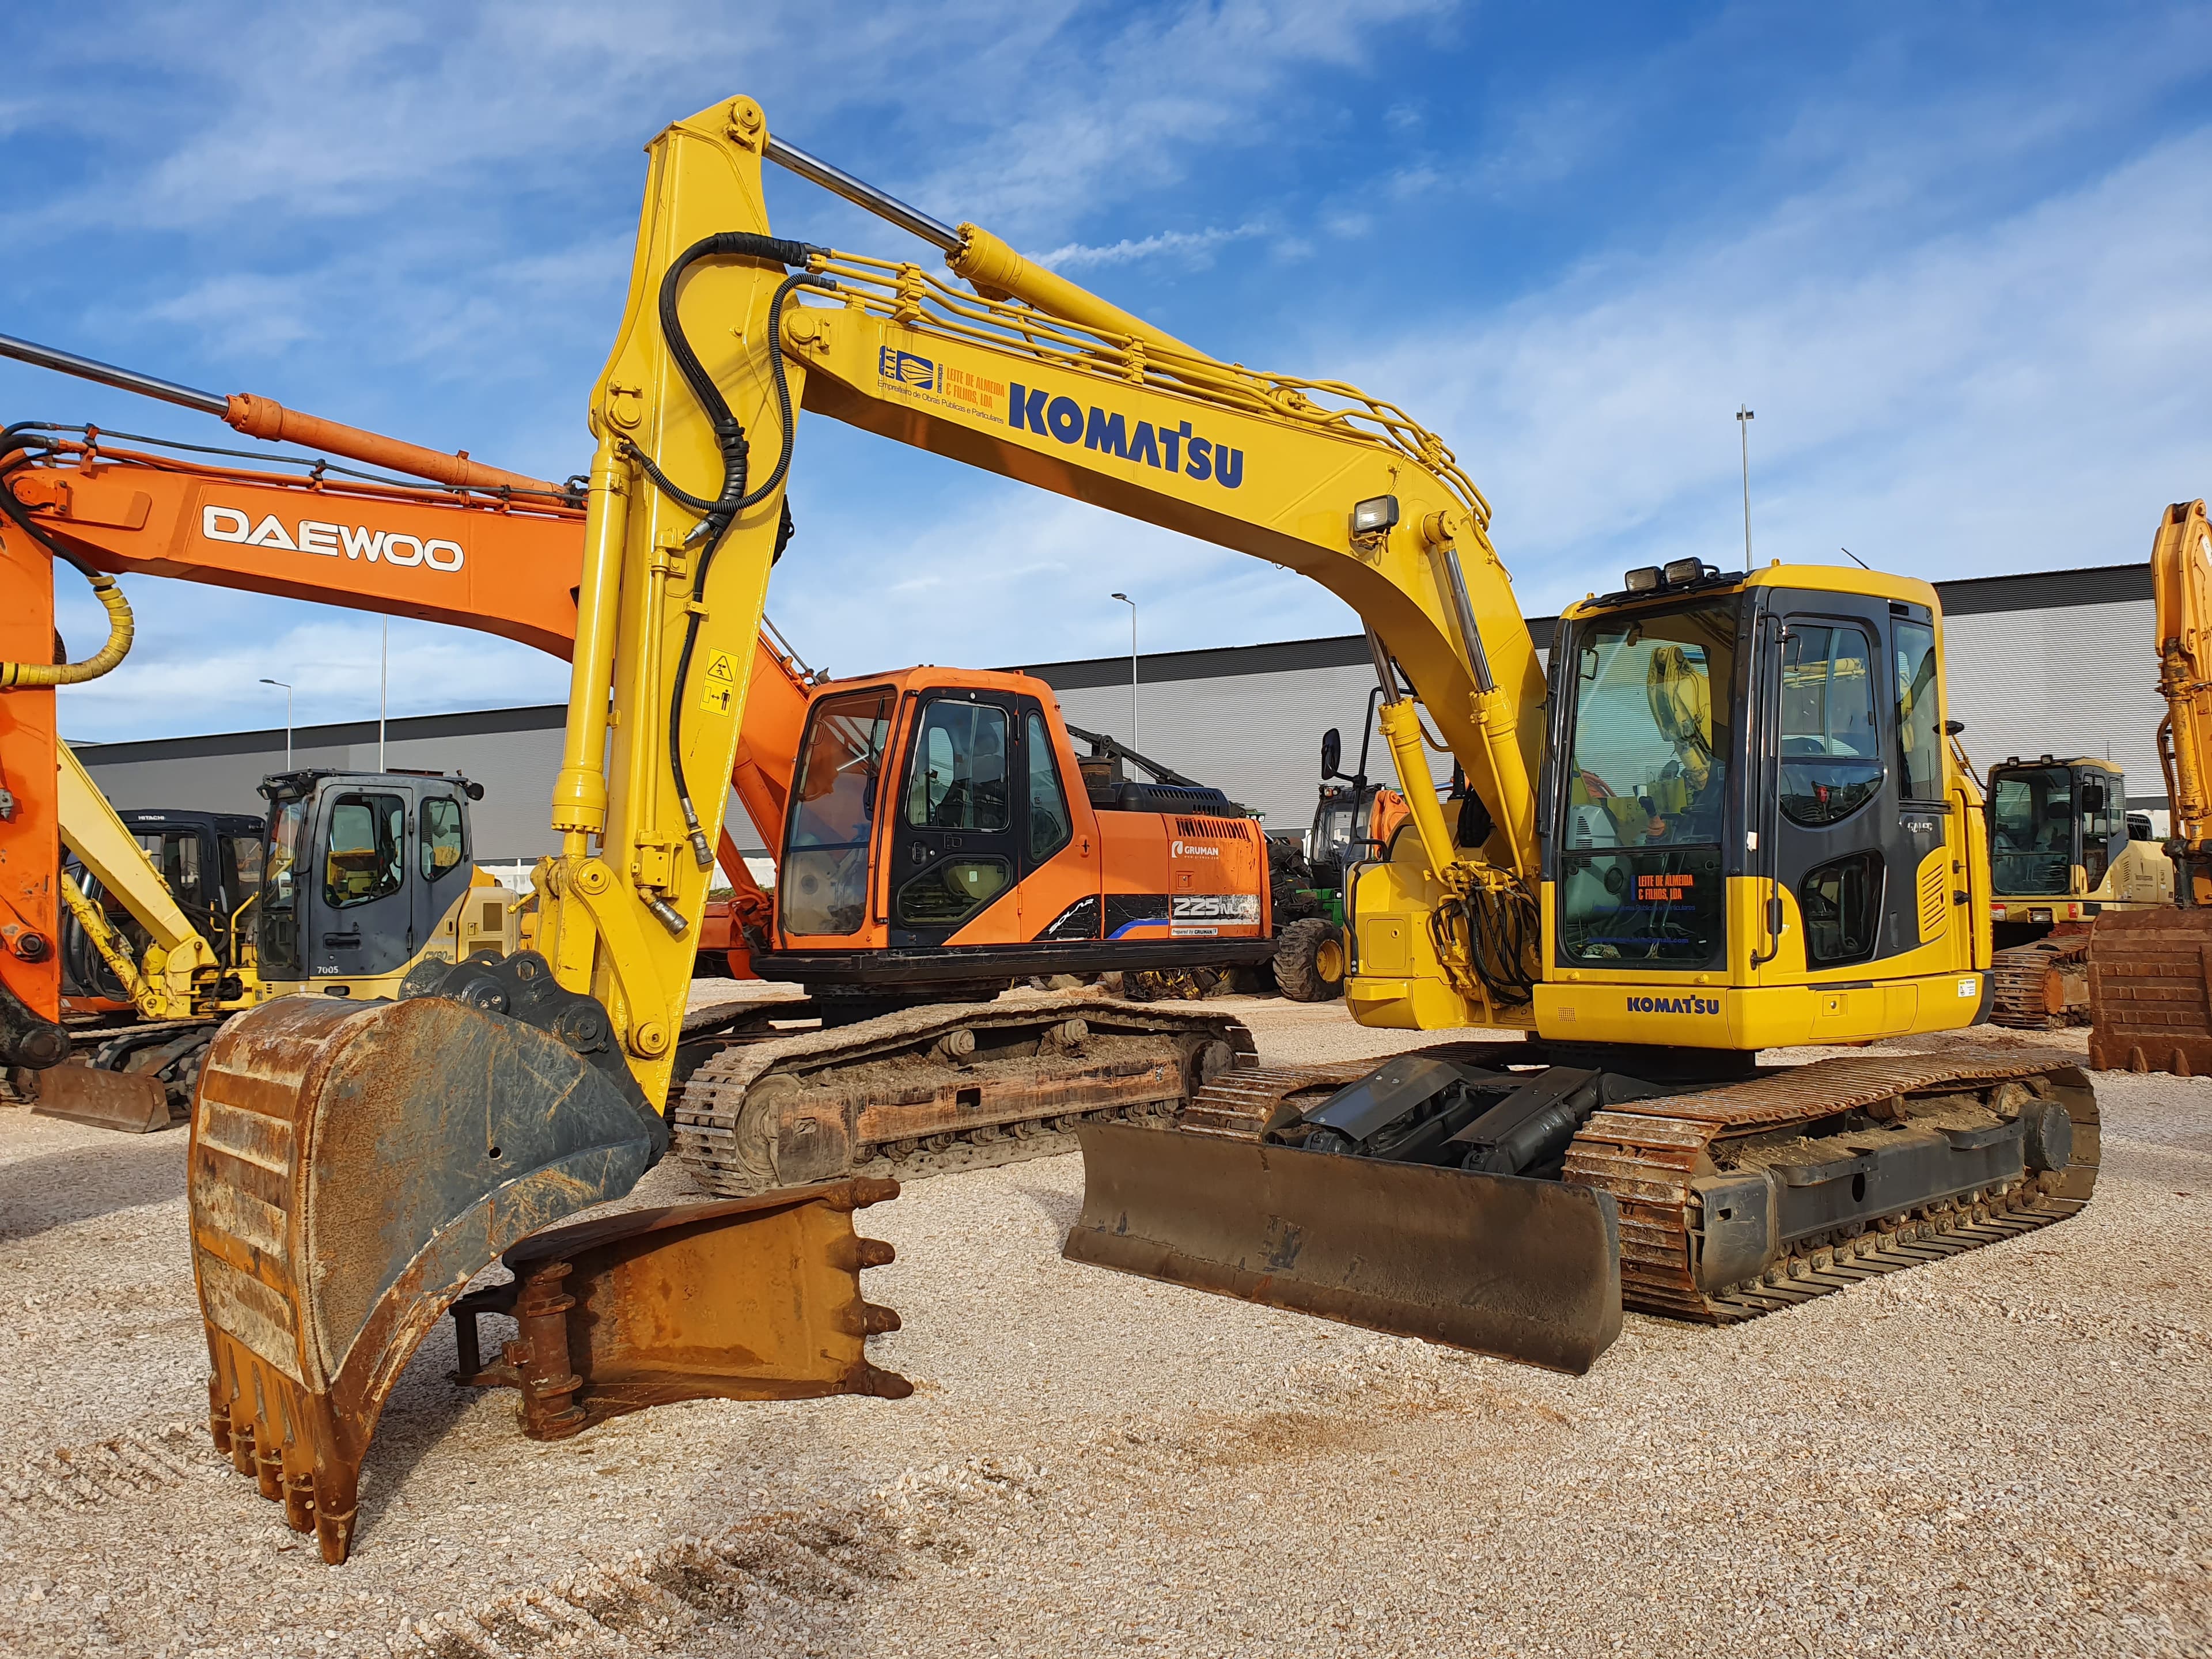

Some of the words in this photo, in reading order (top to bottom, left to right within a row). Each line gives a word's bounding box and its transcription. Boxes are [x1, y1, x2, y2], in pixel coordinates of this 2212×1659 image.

[885, 346, 896, 379] CLAF
[946, 366, 964, 384] LEITE
[965, 373, 974, 388] DE
[976, 376, 1005, 397] ALMEIDA
[946, 382, 952, 396] &
[953, 385, 978, 406] FILHOS,
[980, 392, 993, 409] LDA
[877, 379, 912, 397] Empreiteiro
[913, 390, 922, 399] de
[922, 392, 941, 405] Obras
[941, 399, 966, 413] Públicas
[972, 408, 1004, 425] Particulares
[1009, 381, 1244, 489] KOMATSU
[202, 504, 464, 572] DAEWOO
[1184, 846, 1219, 856] GRUMAN
[1638, 875, 1654, 887] LEITE
[1656, 875, 1664, 887] DE
[1665, 874, 1694, 887] ALMEIDA
[1638, 889, 1643, 900] &
[1645, 888, 1668, 901] FILHOS,
[1670, 888, 1683, 899] LDA
[1048, 898, 1094, 934] SOLAR
[317, 965, 339, 974] 7005
[1627, 994, 1719, 1015] KOMATSU
